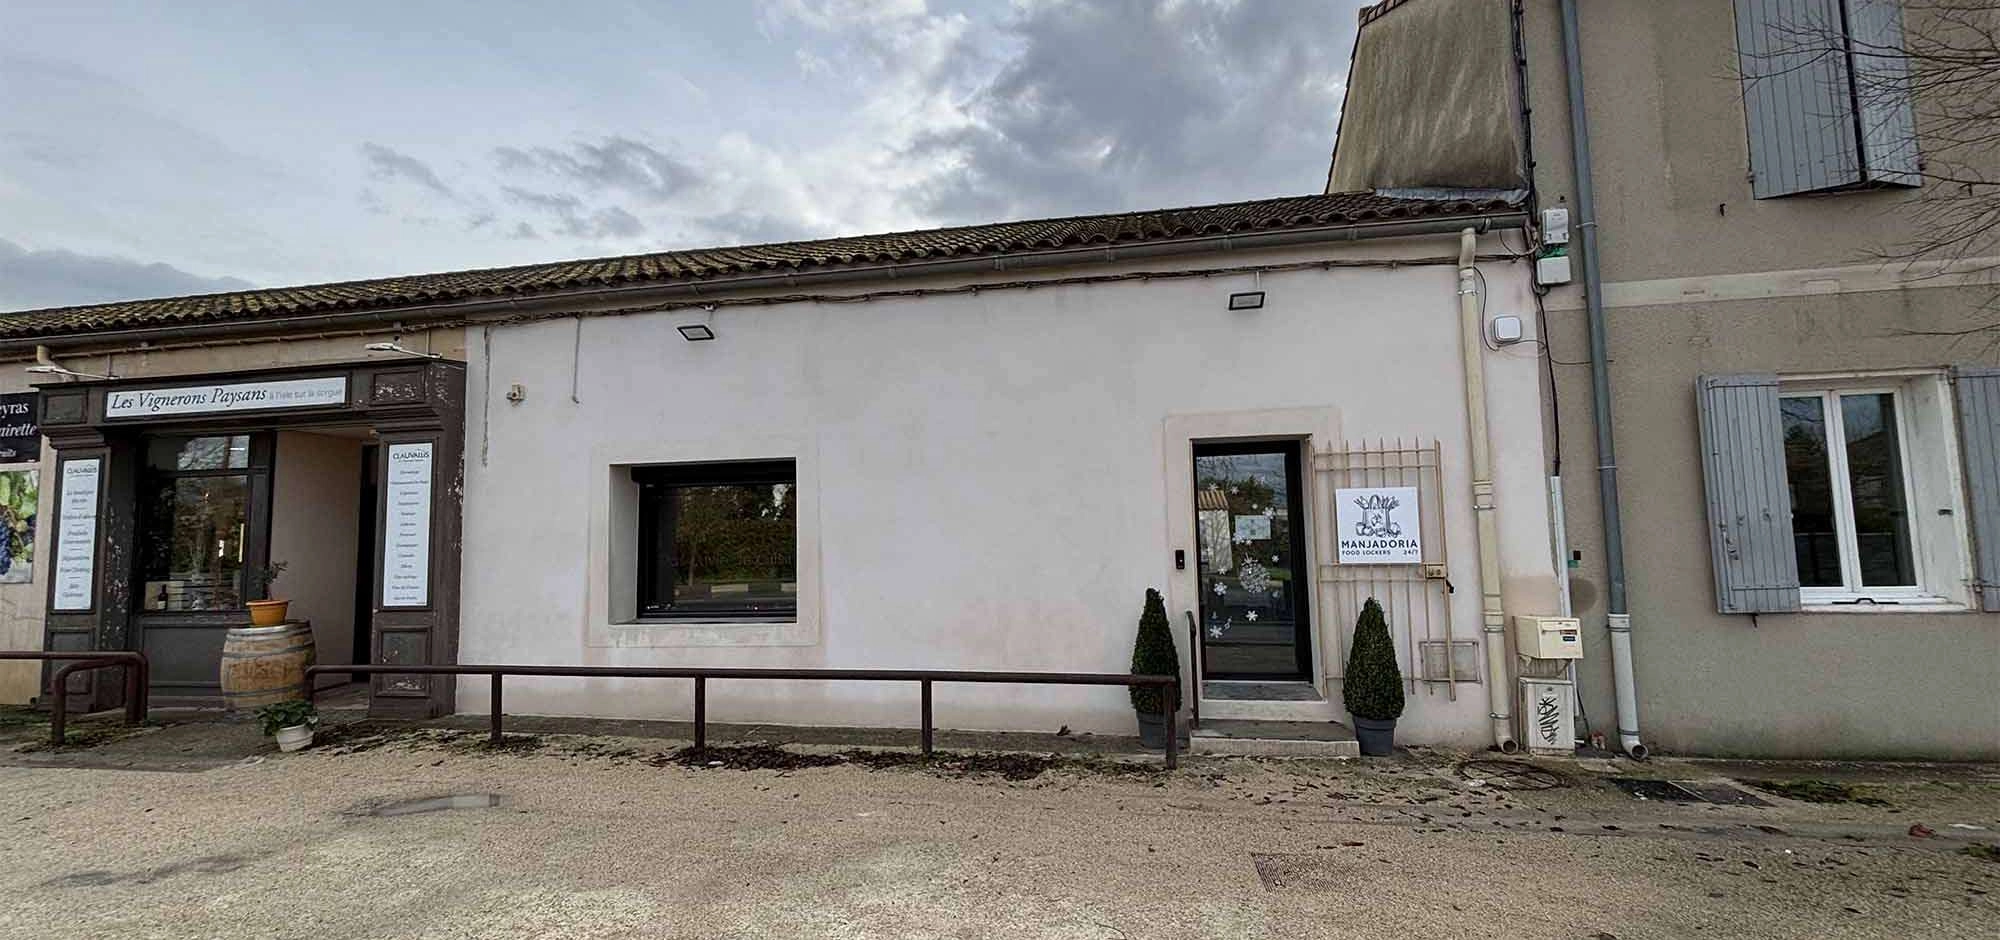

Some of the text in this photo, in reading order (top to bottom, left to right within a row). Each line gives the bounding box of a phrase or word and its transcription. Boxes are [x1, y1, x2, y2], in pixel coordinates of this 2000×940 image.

[112, 394, 133, 409] Les
[139, 391, 207, 412] Vignerons
[211, 387, 268, 408] Paysans
[1341, 540, 1418, 549] MANJADORIA
